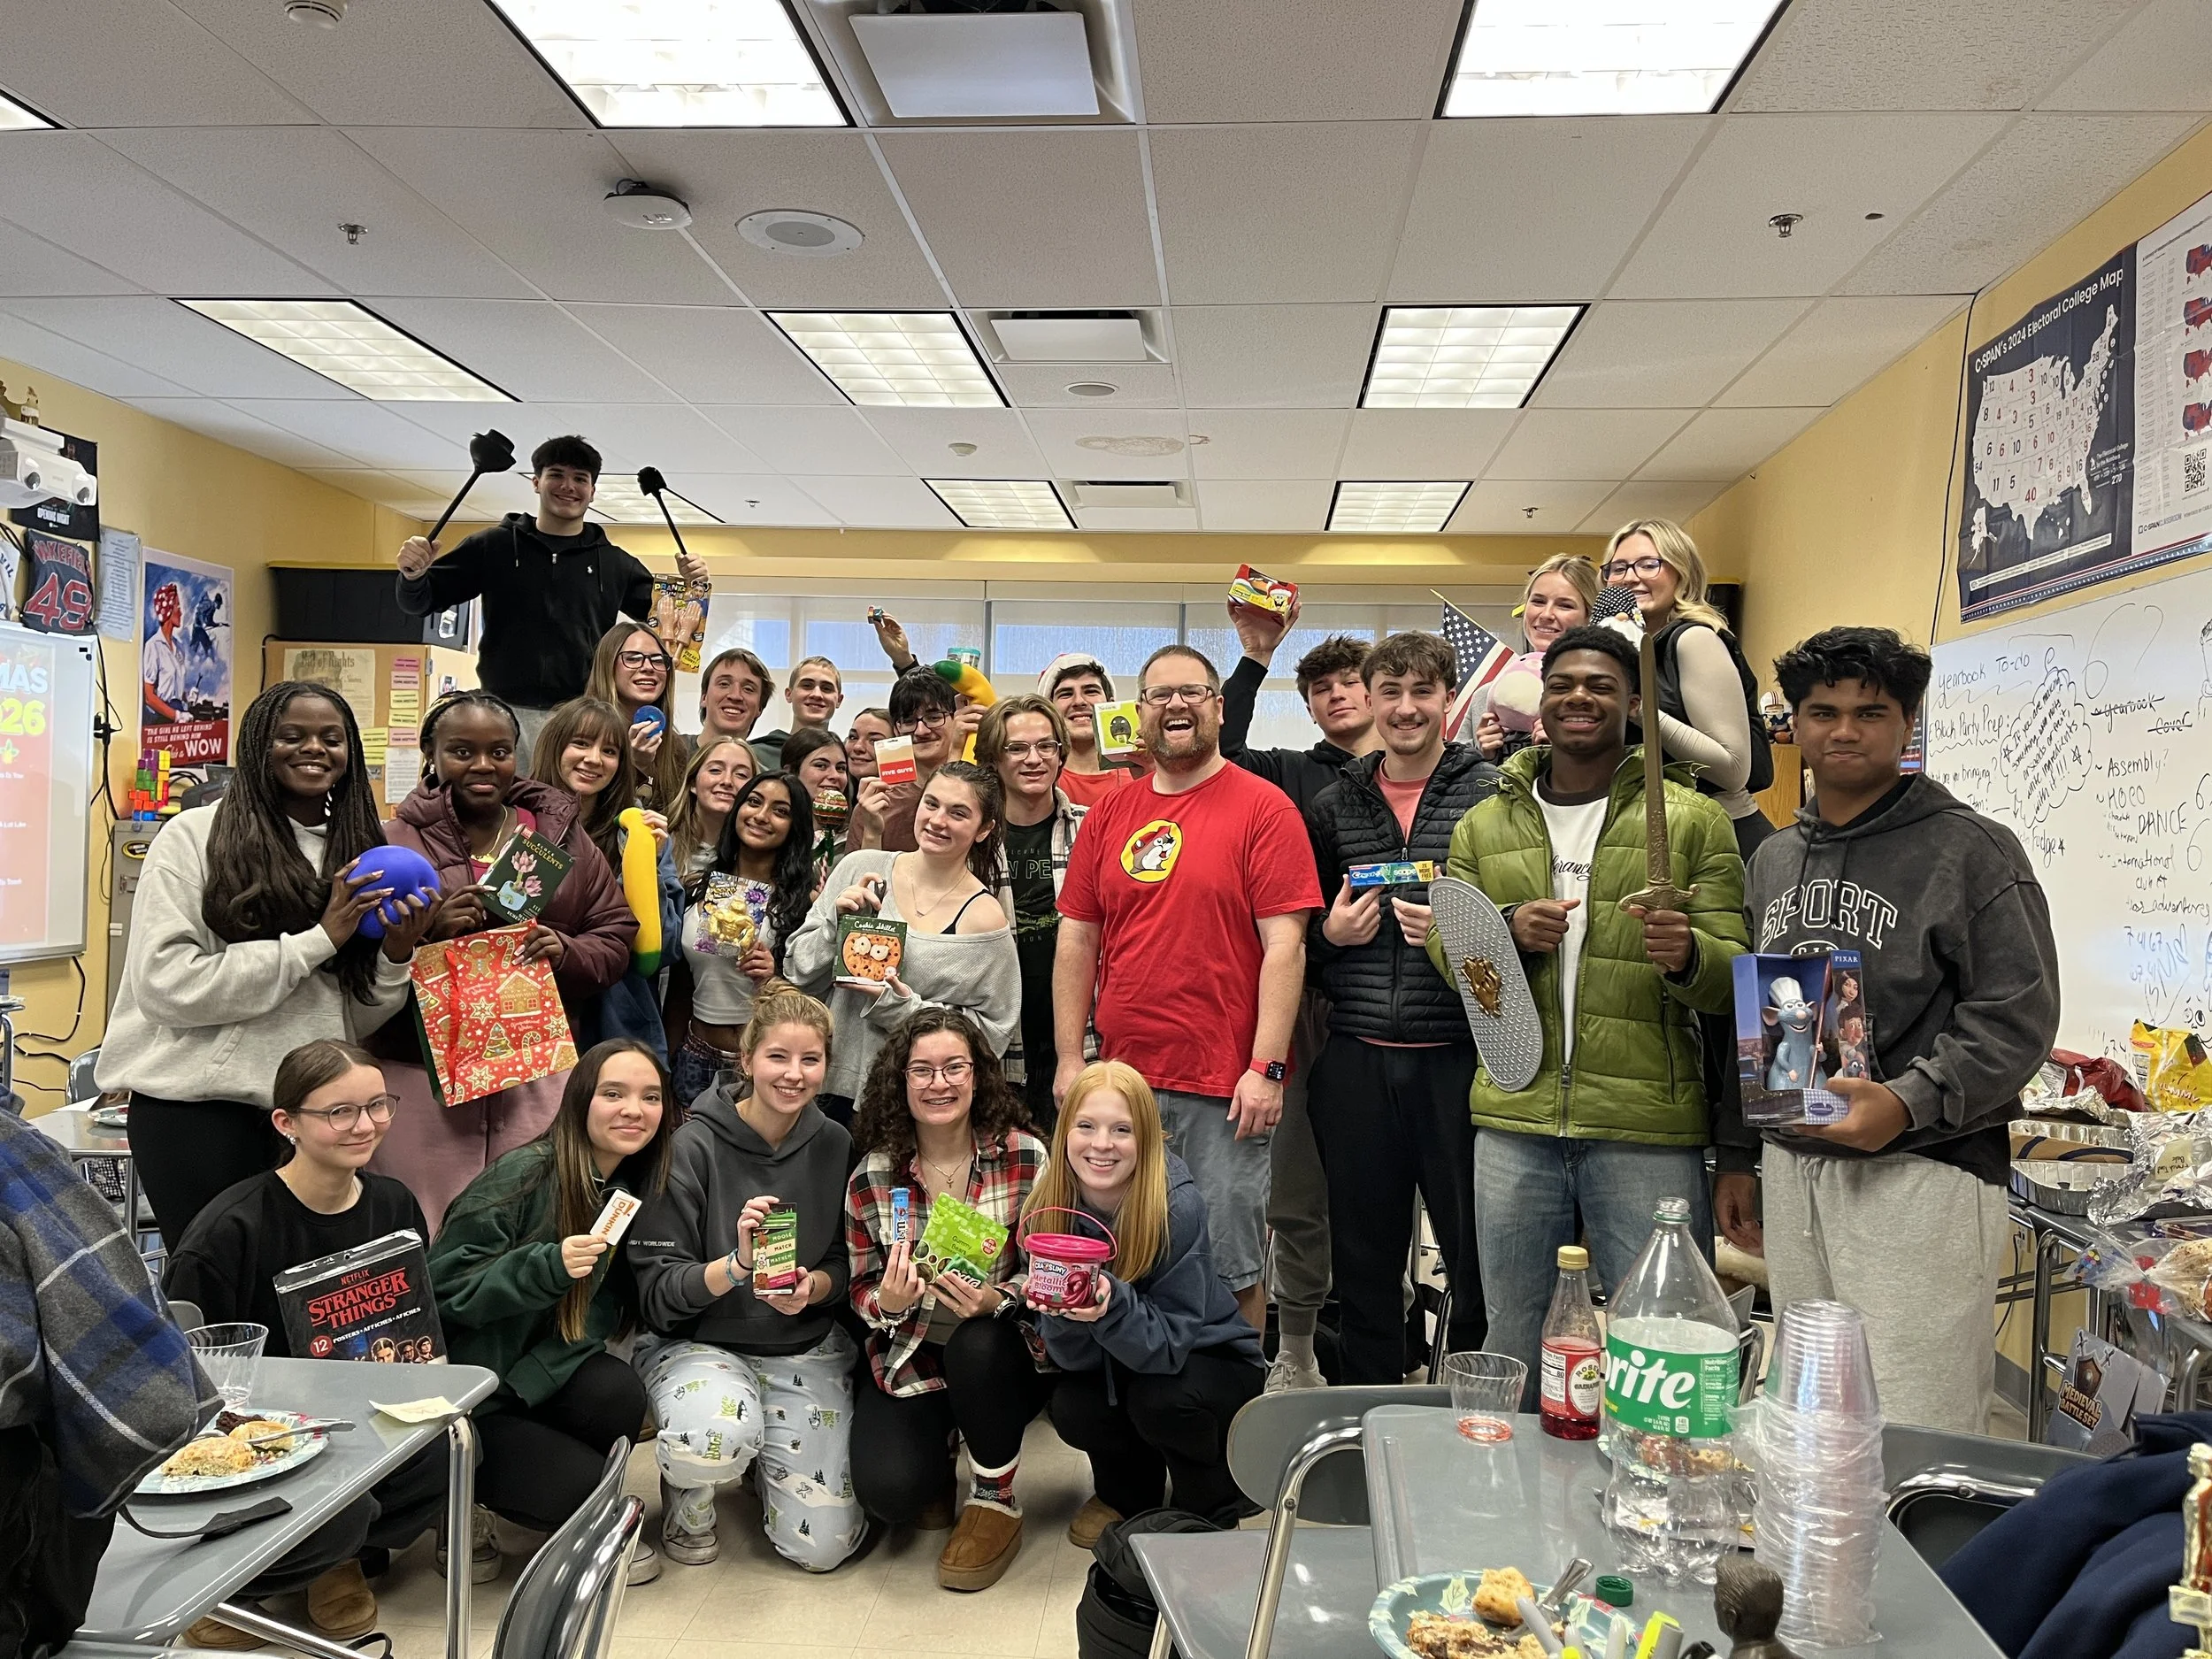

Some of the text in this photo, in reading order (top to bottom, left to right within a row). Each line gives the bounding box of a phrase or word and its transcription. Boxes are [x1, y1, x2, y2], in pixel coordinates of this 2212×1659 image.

[2008, 327, 2026, 350] 2024
[2027, 303, 2062, 337] Electoral
[2062, 282, 2098, 313] College
[2100, 268, 2124, 292] Map
[2028, 368, 2034, 382] 3
[2040, 373, 2047, 386] 10
[2053, 375, 2060, 388] 10
[1989, 380, 1995, 392] 12
[2009, 379, 2015, 393] 4
[2030, 390, 2035, 404] 3
[1983, 408, 1989, 421] 8
[1997, 408, 2001, 420] 4
[2012, 411, 2017, 424] 3
[2029, 414, 2036, 428] 5
[2047, 432, 2055, 444] 10
[1986, 442, 1993, 456] 6
[1999, 443, 2005, 457] 6
[2013, 439, 2021, 455] 10
[2038, 457, 2042, 472] 7
[1993, 478, 2000, 492] 11
[2009, 475, 2016, 488] 5
[2024, 487, 2037, 503] 40
[24, 572, 93, 631] 49
[327, 650, 355, 668] Rights
[0, 698, 46, 736] 26
[2032, 701, 2043, 720] are
[185, 738, 222, 757] WOW
[2042, 720, 2078, 775] ingredients
[2138, 802, 2187, 837] DANCE
[522, 839, 564, 870] SUCCULENTS
[1352, 870, 1382, 879] Crest
[1761, 879, 1898, 953] SPORT
[875, 923, 896, 933] Skillet
[951, 1244, 966, 1255] Bears
[952, 1236, 972, 1250] Gummy
[340, 1269, 370, 1286] NETFLIX
[1033, 1274, 1068, 1286] Metallic
[308, 1271, 411, 1323] STRANGER
[326, 1294, 397, 1330] THINGS
[333, 1307, 421, 1344] POSTERS AFFICHES AFICHES
[312, 1339, 329, 1354] 12
[2061, 1381, 2101, 1417] MEDIEVAL
